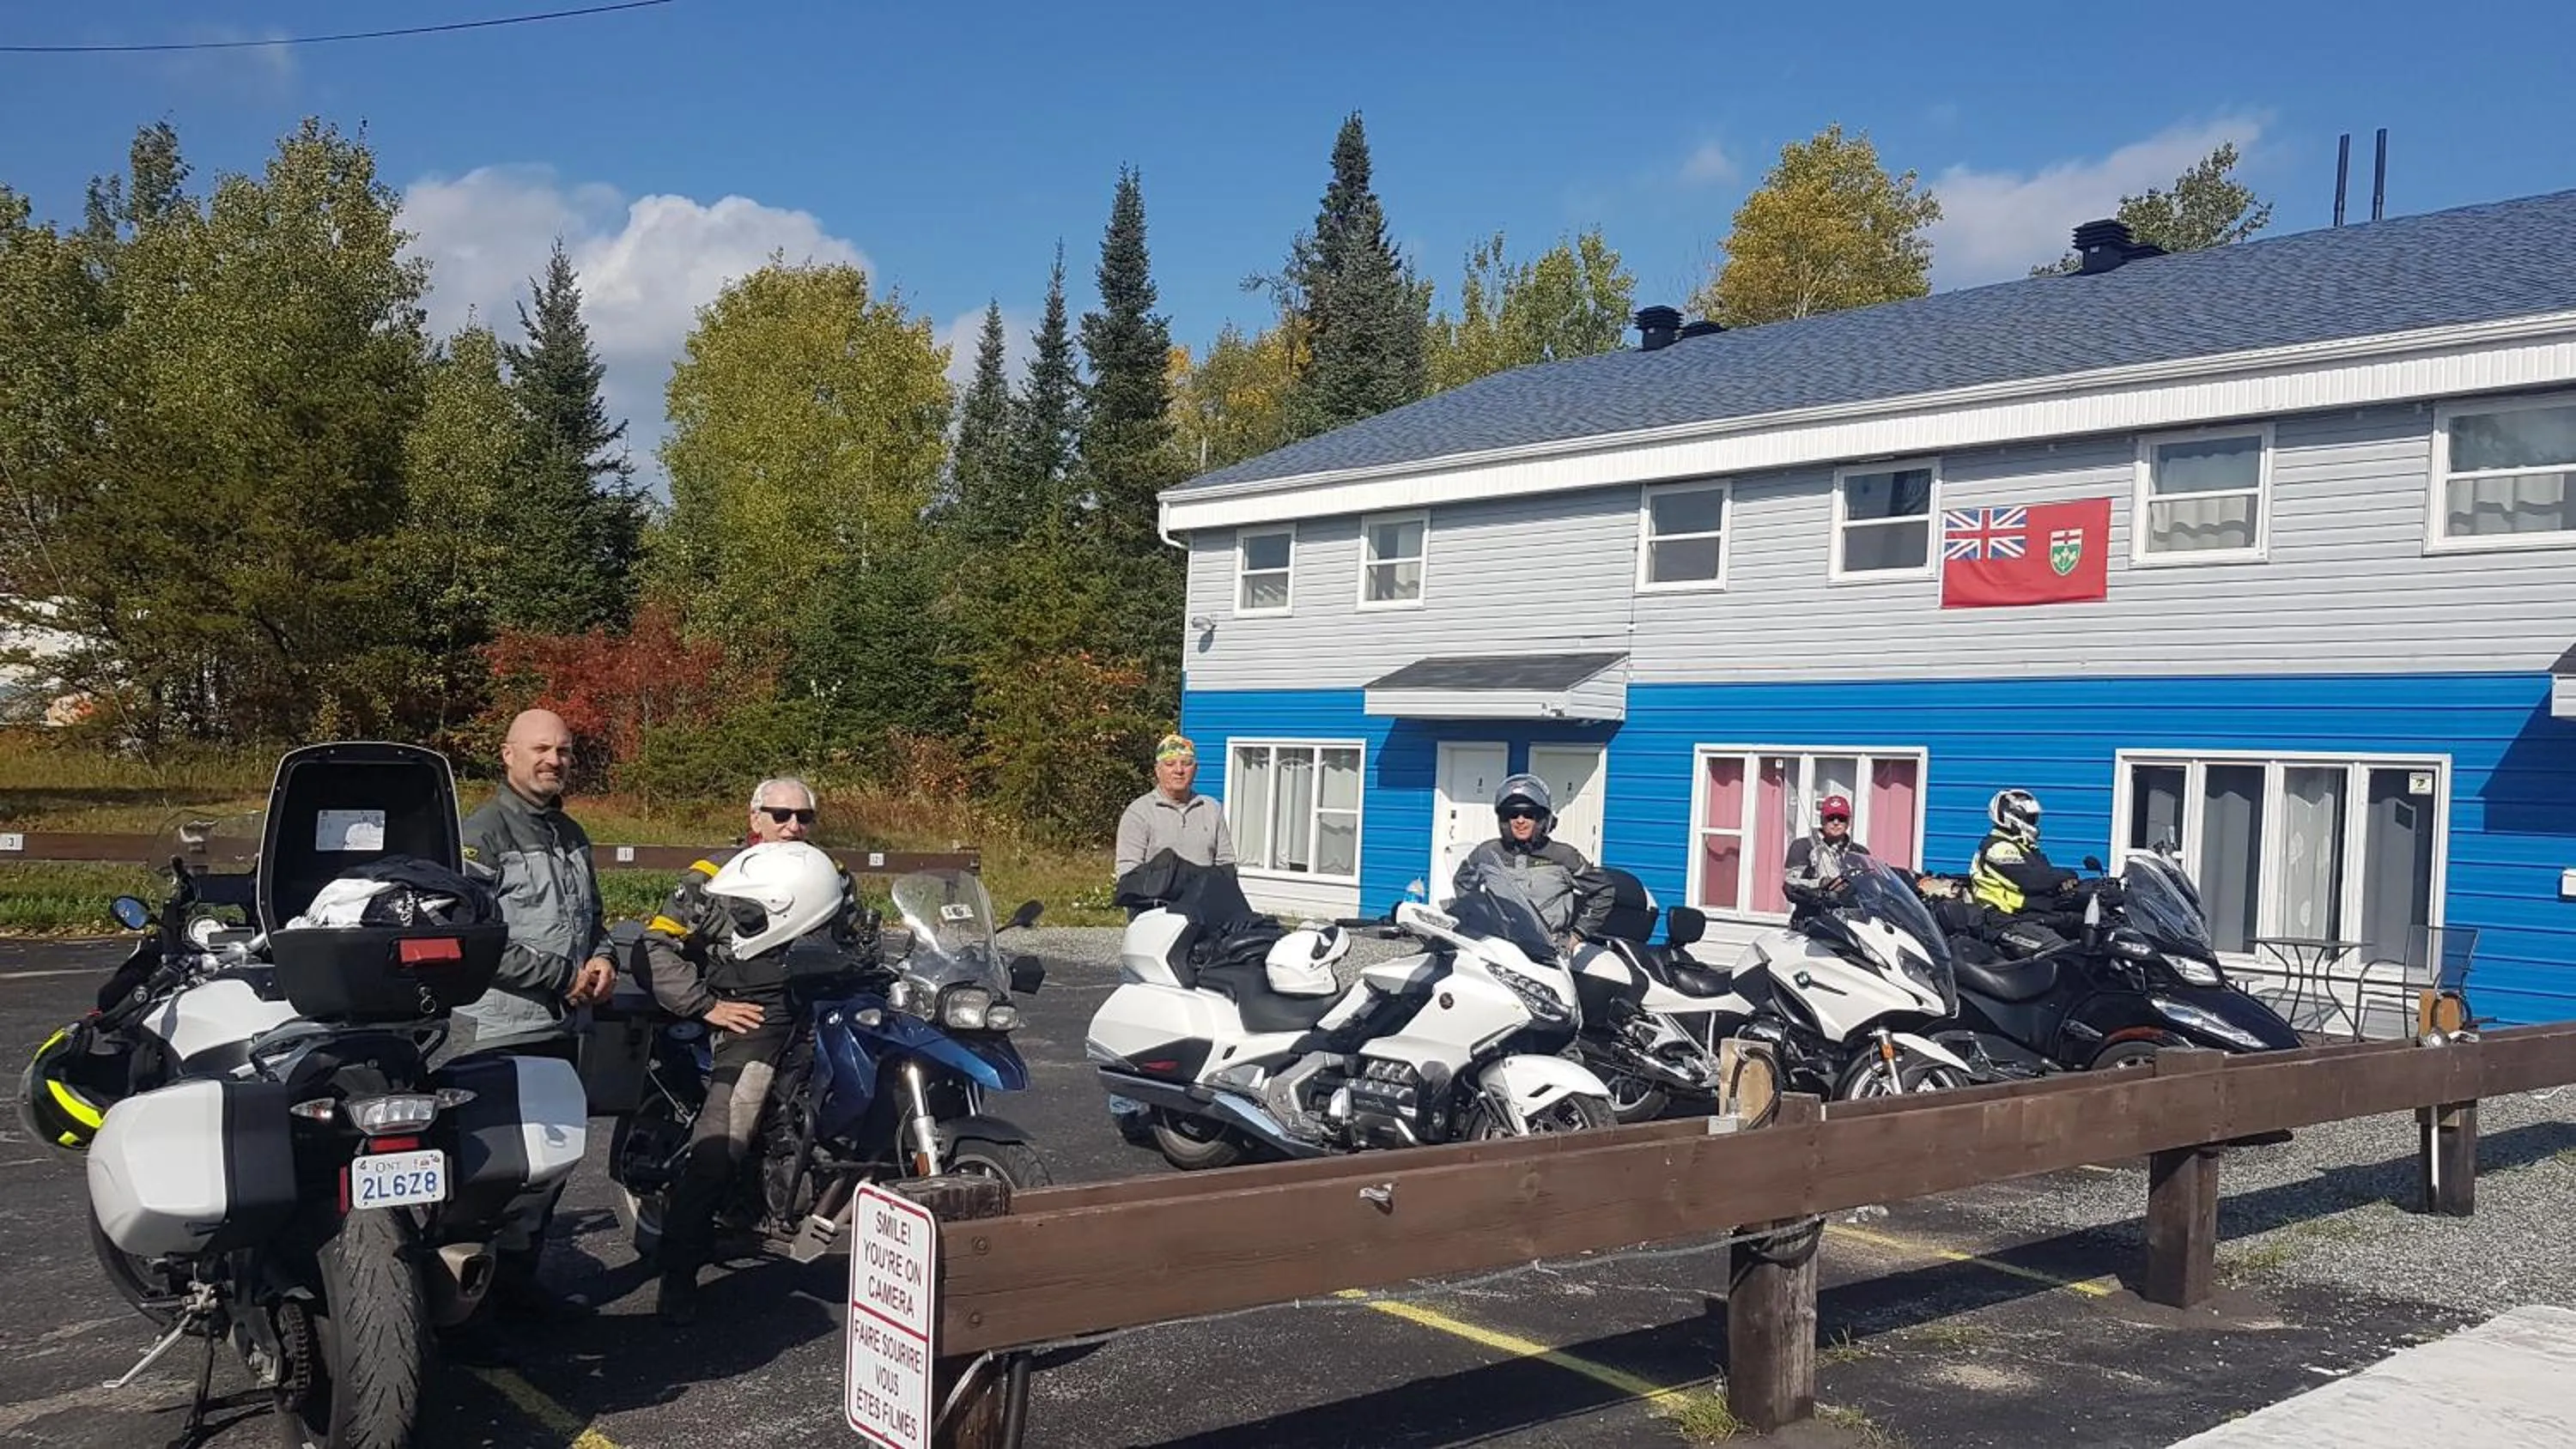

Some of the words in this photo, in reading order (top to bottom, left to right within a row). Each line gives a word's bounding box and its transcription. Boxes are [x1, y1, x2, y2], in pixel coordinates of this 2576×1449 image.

[361, 1171, 437, 1200] 2L6Z8
[875, 1210, 911, 1247] SMILE!
[863, 1238, 903, 1278] YOU'RE
[906, 1258, 921, 1287] ON
[868, 1275, 914, 1319] CAMERA
[854, 1319, 880, 1353] FAIRE
[882, 1333, 921, 1374] SOURIRE
[876, 1363, 899, 1397] VOUS
